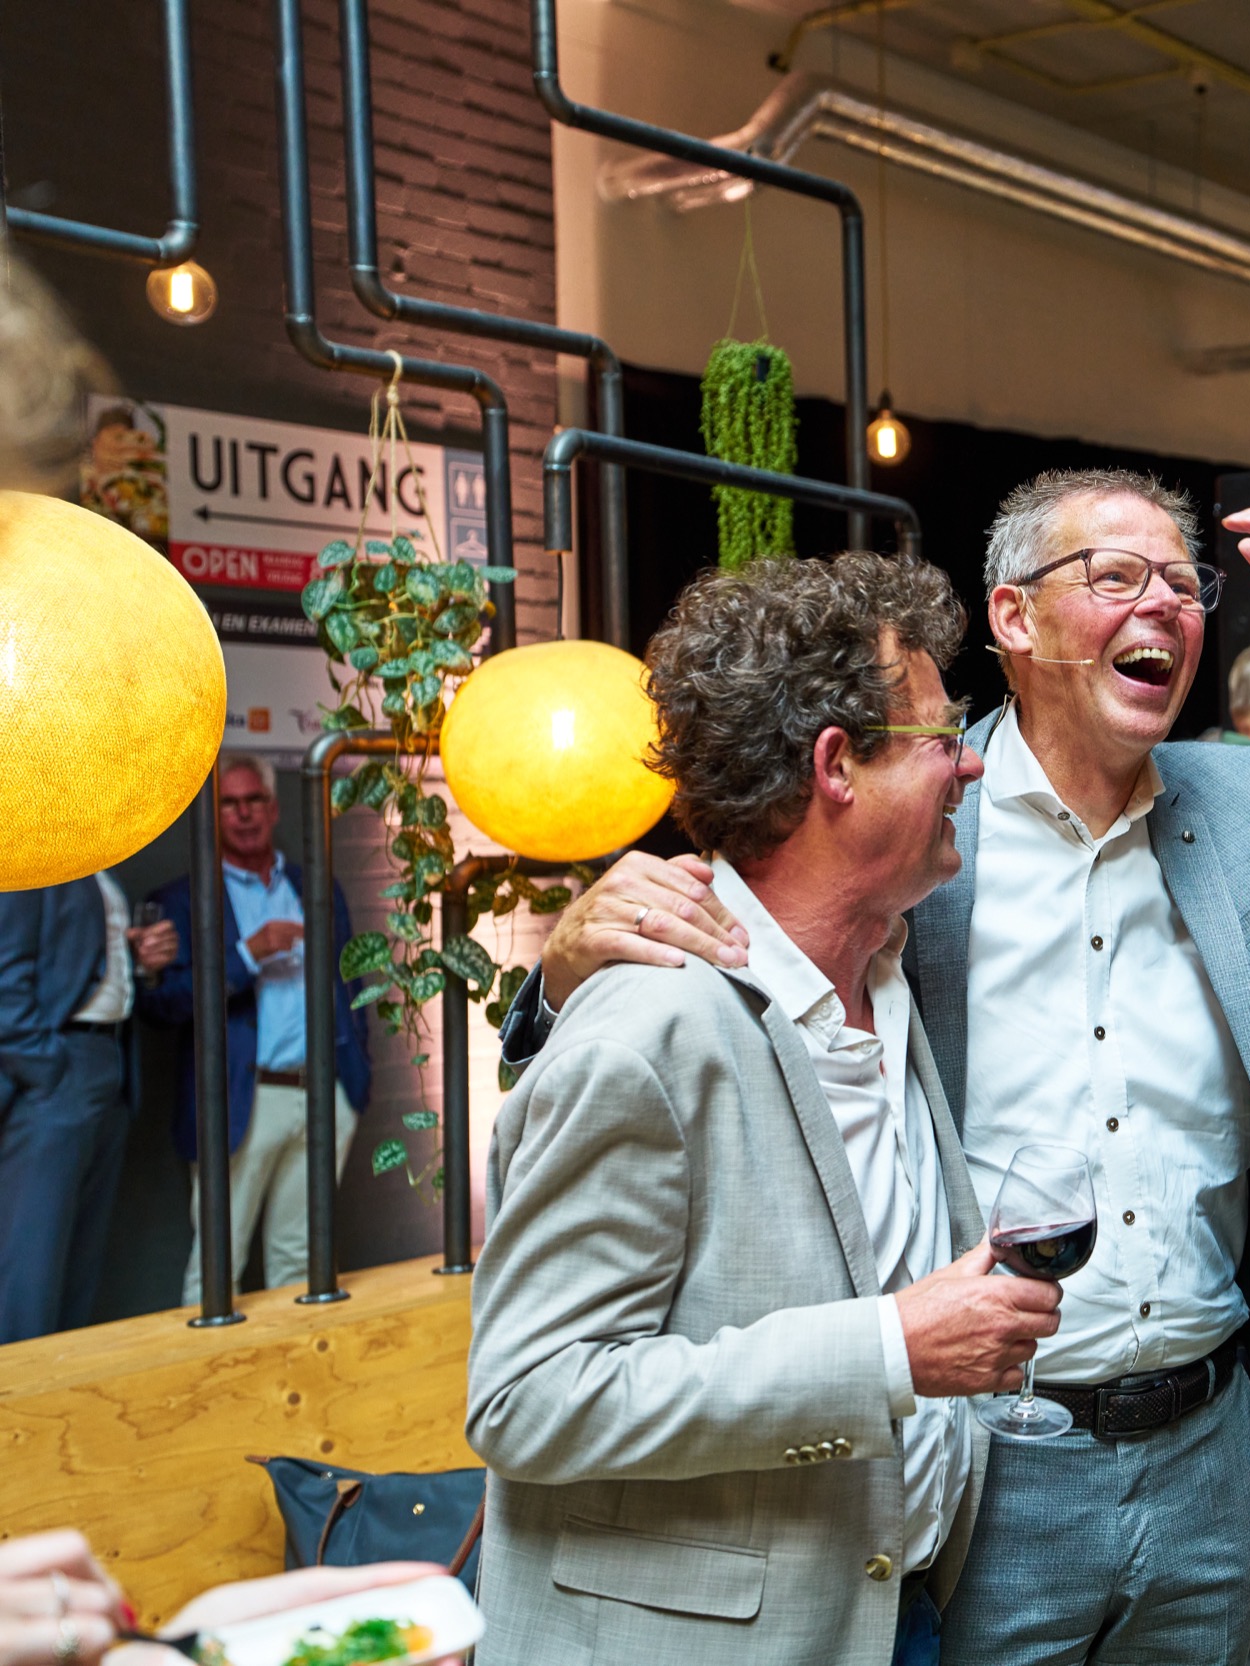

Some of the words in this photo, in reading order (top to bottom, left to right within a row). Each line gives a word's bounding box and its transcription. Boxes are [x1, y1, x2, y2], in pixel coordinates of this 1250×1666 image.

[189, 433, 425, 516] UITGANG
[182, 546, 259, 581] OPEN
[221, 613, 246, 632] EN
[247, 615, 318, 637] EXAMEN
